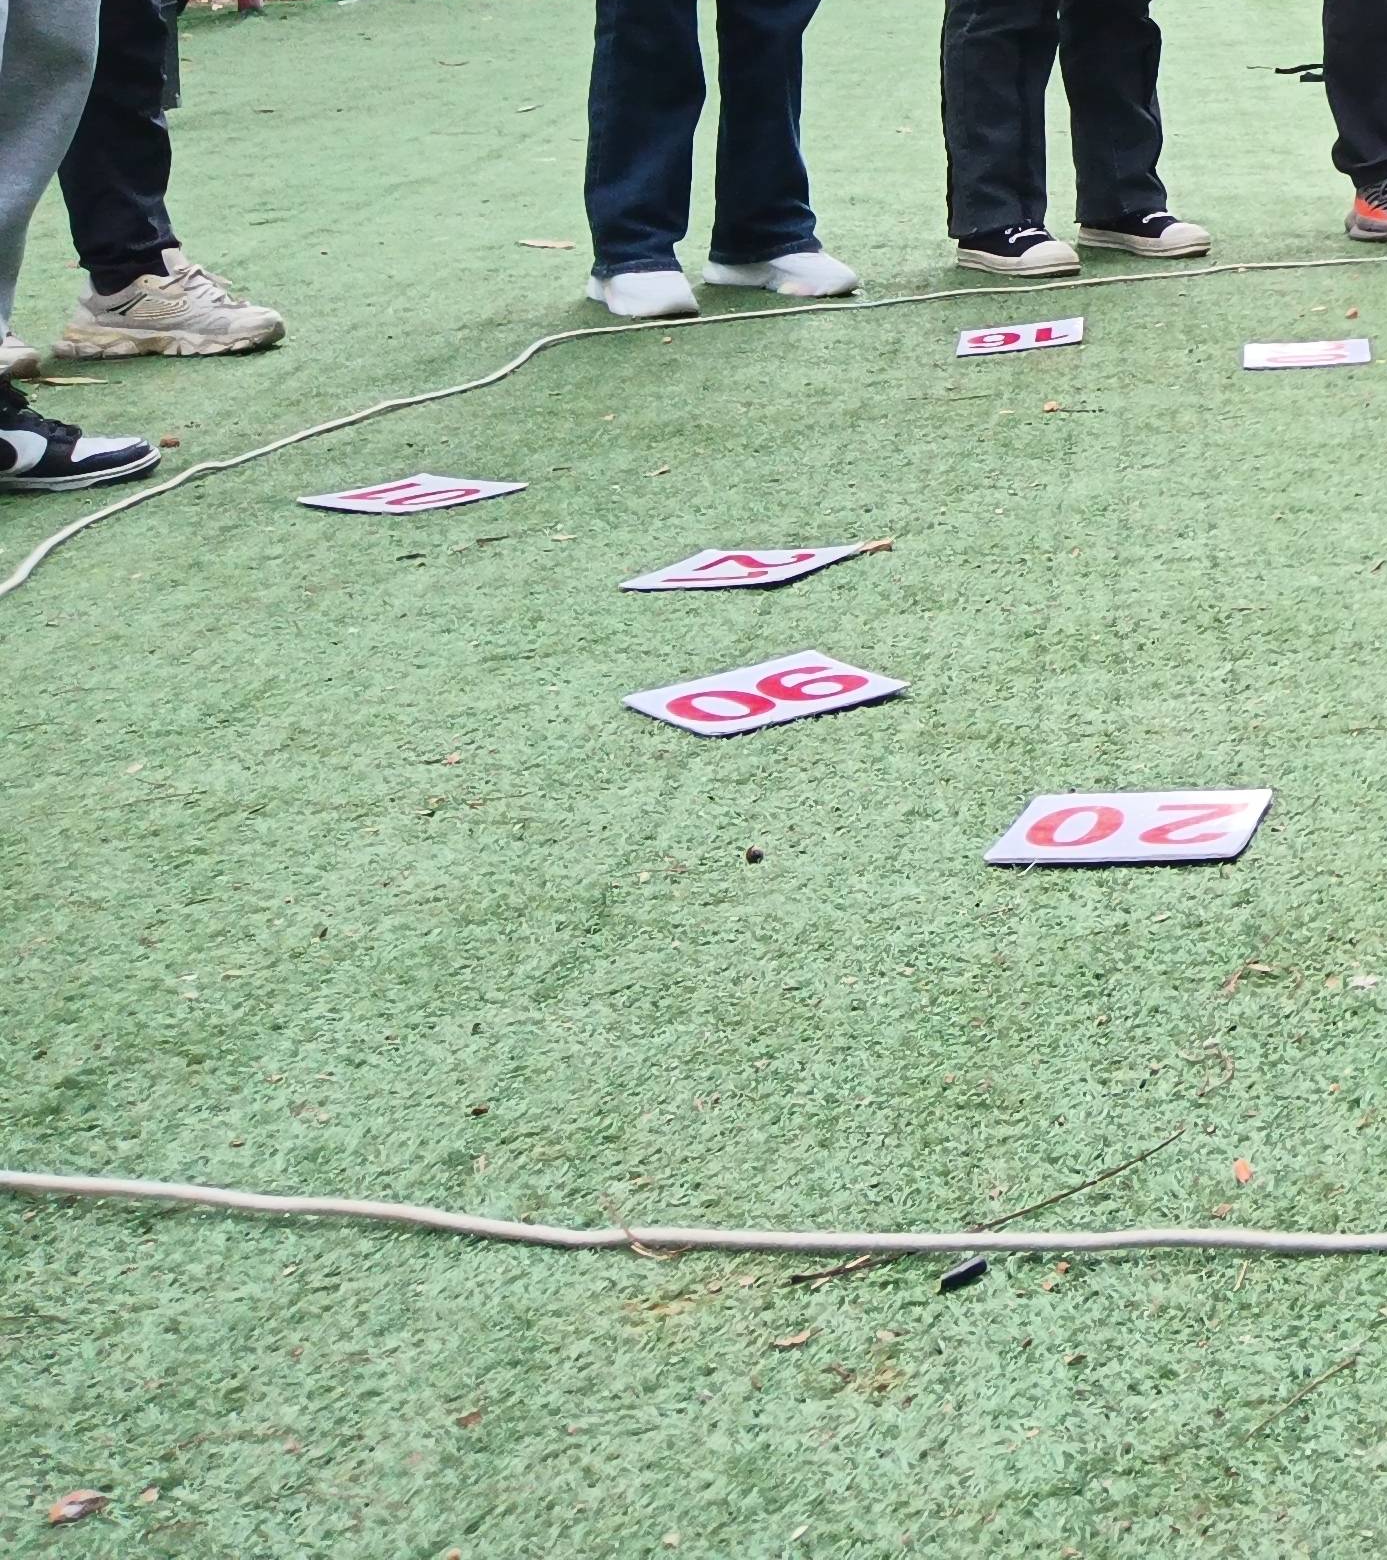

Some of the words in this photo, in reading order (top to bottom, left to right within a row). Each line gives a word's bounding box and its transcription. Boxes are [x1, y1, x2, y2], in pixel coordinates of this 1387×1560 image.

[968, 326, 1069, 349] 16
[666, 665, 870, 723] 06
[1025, 804, 1238, 848] 20
